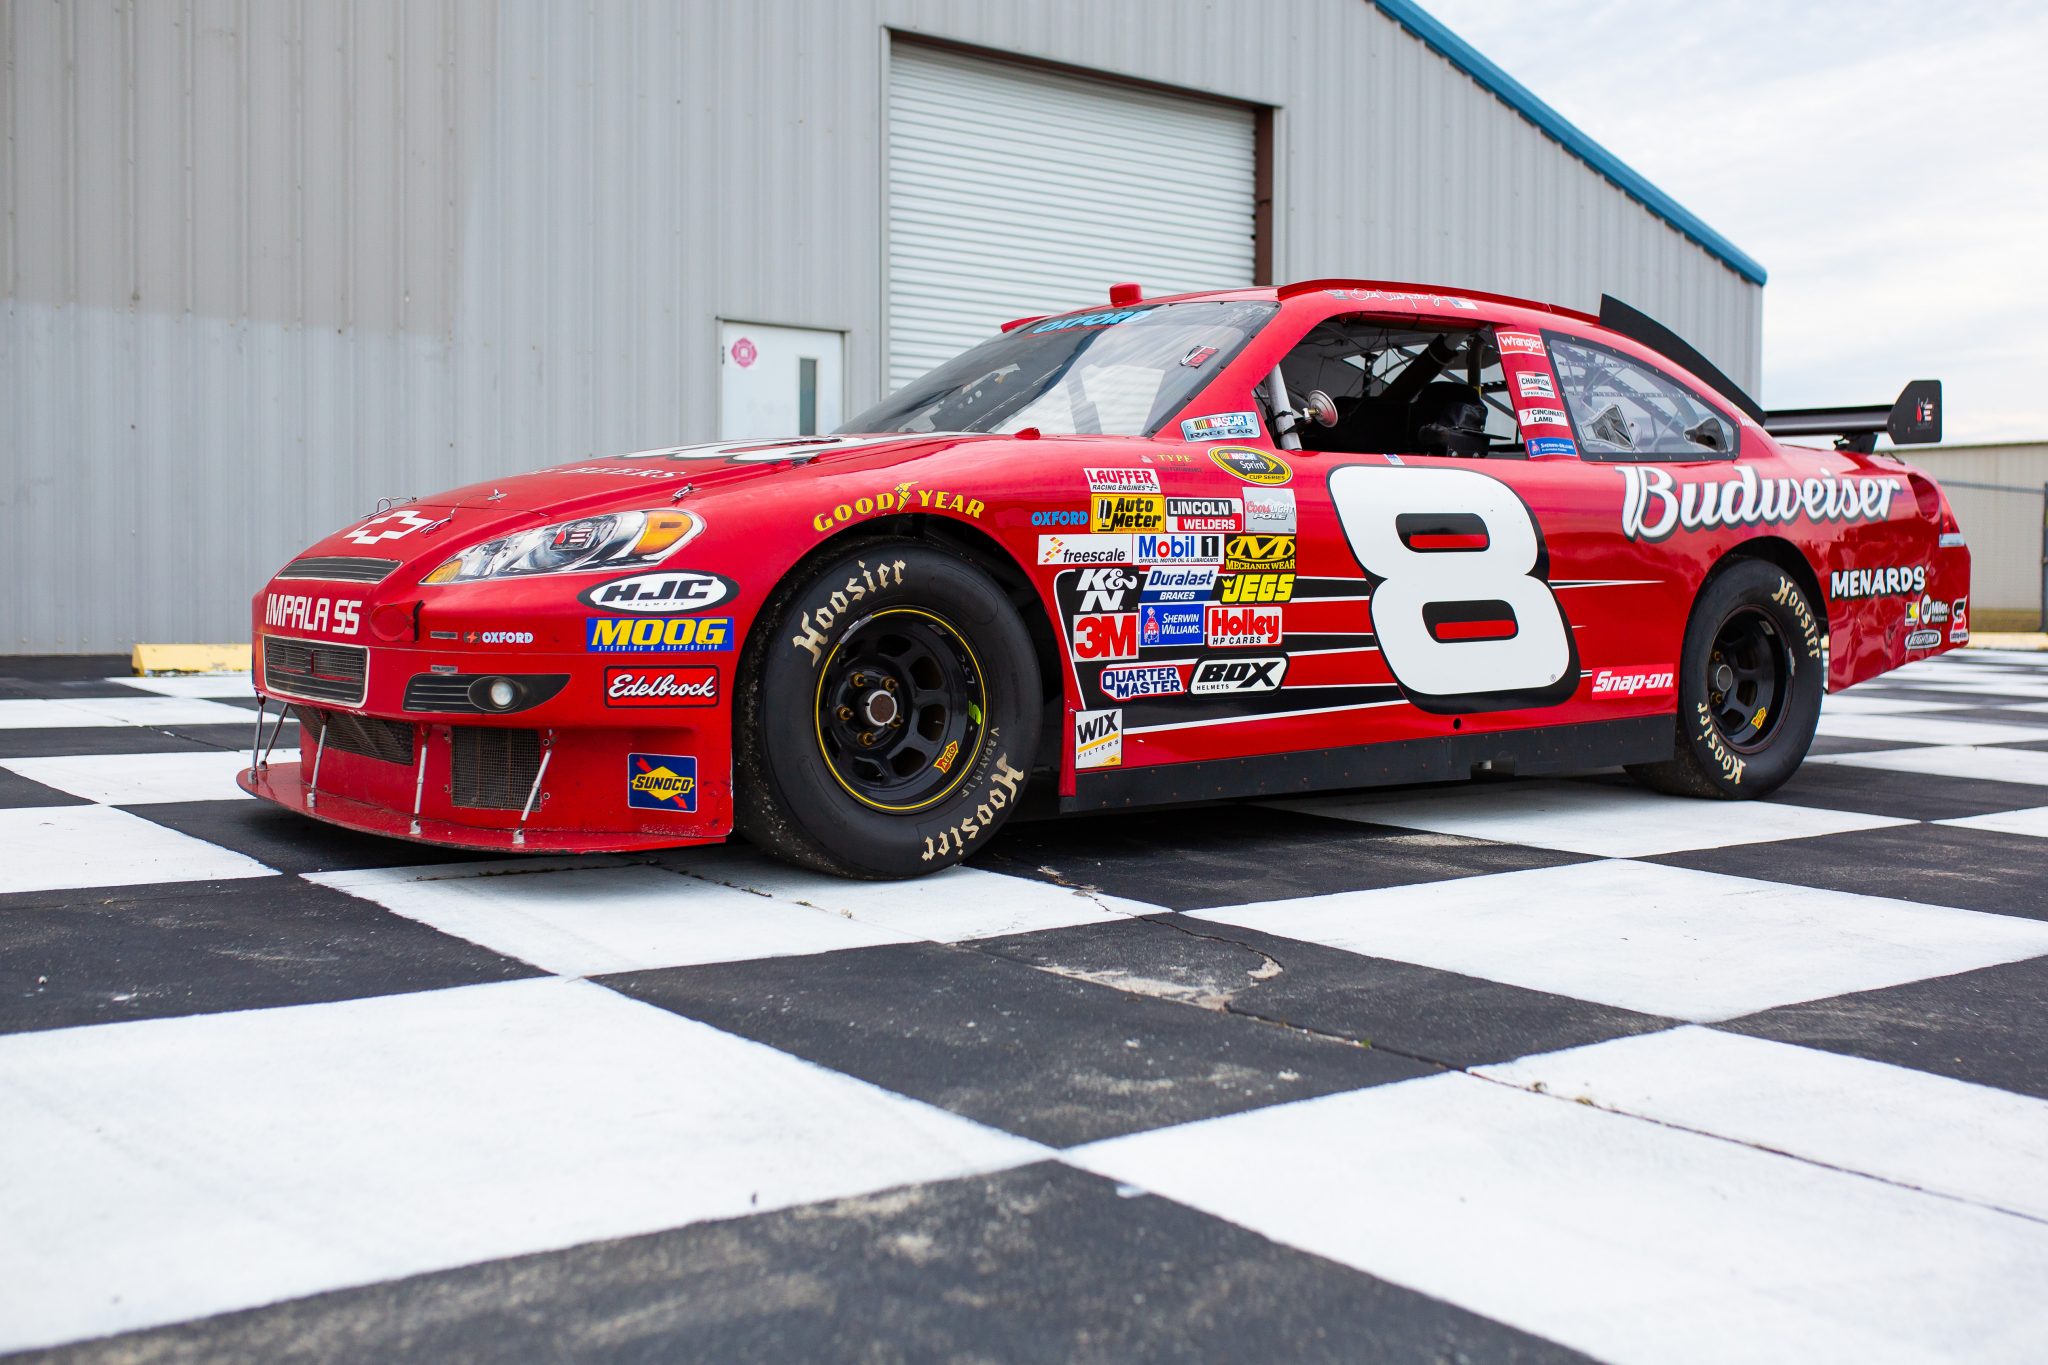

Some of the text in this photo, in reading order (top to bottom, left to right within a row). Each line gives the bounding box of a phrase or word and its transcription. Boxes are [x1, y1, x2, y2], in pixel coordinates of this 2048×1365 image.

[1500, 336, 1542, 351] Wrangler
[1521, 378, 1550, 386] CHAMPION
[1211, 415, 1245, 427] NASCAR
[1190, 428, 1225, 439] RACE
[1158, 454, 1191, 462] TYPE
[1240, 461, 1266, 470] Sprint
[1087, 469, 1154, 484] LAUFFER
[1115, 498, 1153, 512] Auto
[1170, 501, 1229, 515] LINCOLN
[1246, 501, 1295, 514] Coors LIGHT
[1615, 466, 1901, 541] Budweiser
[1031, 511, 1088, 525] OXFORD
[1112, 513, 1161, 528] Meter
[1184, 519, 1236, 530] WELDERS
[1139, 536, 1194, 557] Mobil
[1064, 548, 1126, 562] freescale
[1226, 559, 1295, 570] MECHANIX WEAR
[1149, 570, 1213, 585] Duralast
[1329, 465, 1570, 696] 8
[1831, 566, 1926, 598] MENARDS
[601, 580, 713, 602] HJC
[1160, 592, 1195, 600] BRAKES
[1222, 574, 1295, 602] JEGS
[266, 593, 362, 635] IMPALA SS
[793, 560, 906, 667] Hoosier
[1162, 613, 1199, 624] SHERWIN
[1771, 576, 1820, 659] Hoosier
[592, 619, 727, 645] MOOG
[1212, 609, 1279, 643] Holley
[482, 632, 533, 643] OXFORD
[1075, 615, 1136, 658] 3M
[1213, 637, 1261, 645] HP CARBS
[608, 674, 715, 697] Edelbrock
[1102, 667, 1177, 690] QUARTER
[1593, 671, 1673, 695] Snap-on
[1116, 680, 1180, 697] MASTER
[1077, 711, 1119, 744] WIX
[1078, 739, 1119, 760] FILTERS
[1697, 702, 1746, 784] Hoosier
[942, 747, 955, 767] AERO
[635, 776, 690, 791] SUNOCO
[921, 752, 1024, 861] Hoosier
